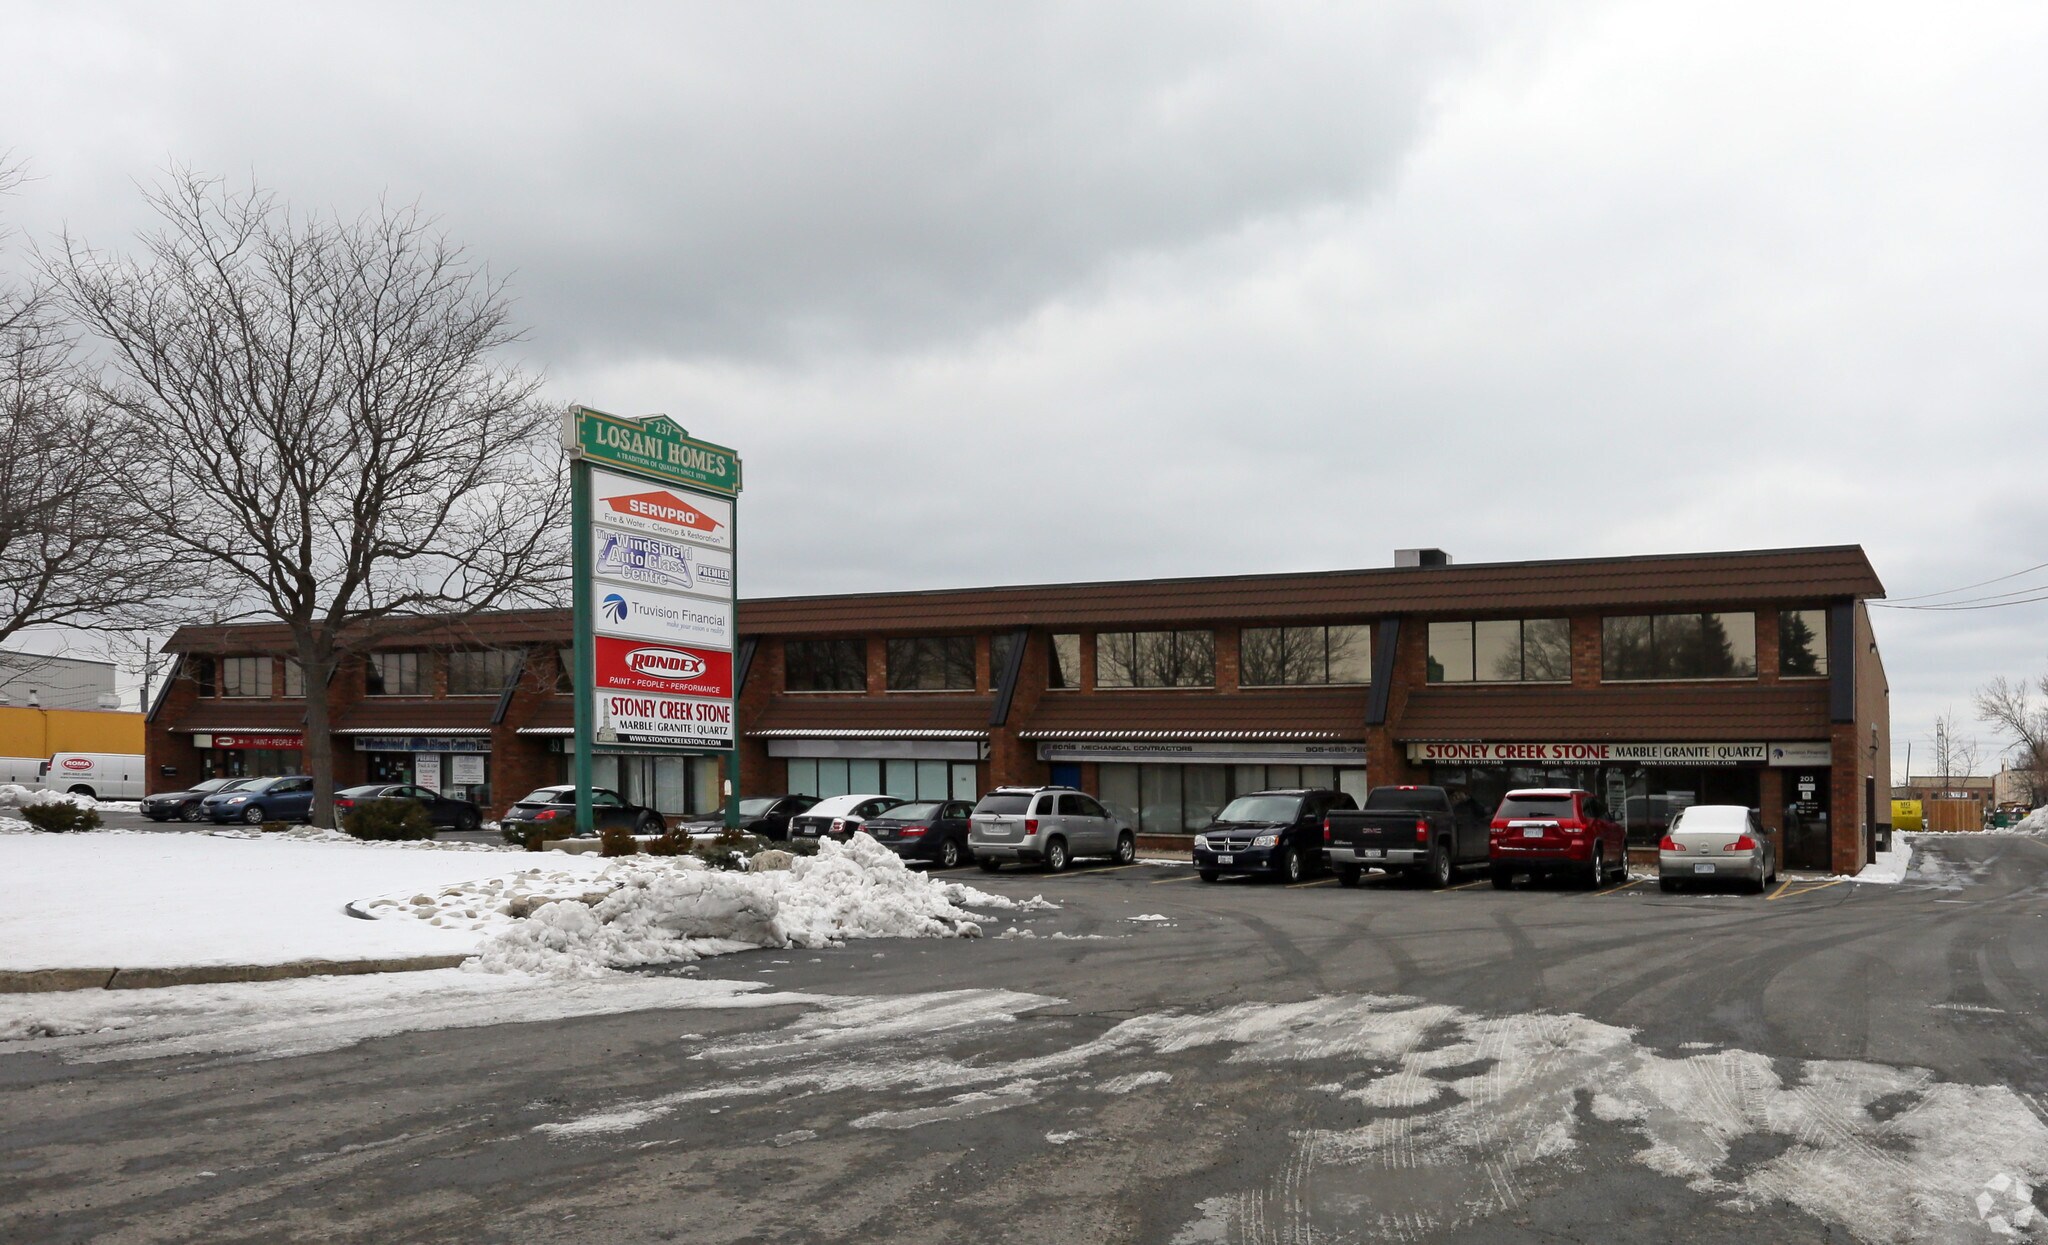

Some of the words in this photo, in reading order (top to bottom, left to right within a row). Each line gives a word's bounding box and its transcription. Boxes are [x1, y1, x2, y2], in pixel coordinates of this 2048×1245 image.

[655, 422, 672, 436] 237
[595, 422, 663, 460] LOSANI
[667, 442, 726, 477] HOMES
[621, 453, 649, 466] TRADITION
[604, 513, 617, 523] Fire
[618, 516, 624, 524] &
[625, 517, 645, 528] Water
[652, 523, 679, 536] Cleanup
[680, 529, 686, 537] &
[615, 532, 692, 561] Windshield
[610, 545, 645, 566] Auto
[647, 553, 686, 573] Glass
[621, 565, 668, 585] Centre
[698, 566, 729, 579] PREMIER
[632, 602, 679, 619] Truvision
[682, 609, 725, 626] Financial
[631, 653, 704, 673] RONDEX
[609, 676, 631, 685] PAINT
[637, 679, 665, 688] PEOPLE
[670, 682, 720, 693] PERFORMANCE
[611, 697, 656, 718] STONEY
[660, 700, 694, 721] CREEK
[696, 703, 730, 723] STONE
[619, 720, 653, 731] MARBLE
[657, 722, 692, 733] GRANITE
[697, 725, 728, 735] QUARTZ
[629, 735, 721, 746] WWW.STONEYCREEKSTONE.COM
[1426, 744, 1490, 758] STONEY
[1494, 744, 1547, 758] CREEK
[1552, 744, 1609, 759] STONE
[1615, 746, 1658, 757] MARBLE
[1664, 746, 1710, 757] GRANITE
[1717, 746, 1763, 759] QUARTZ
